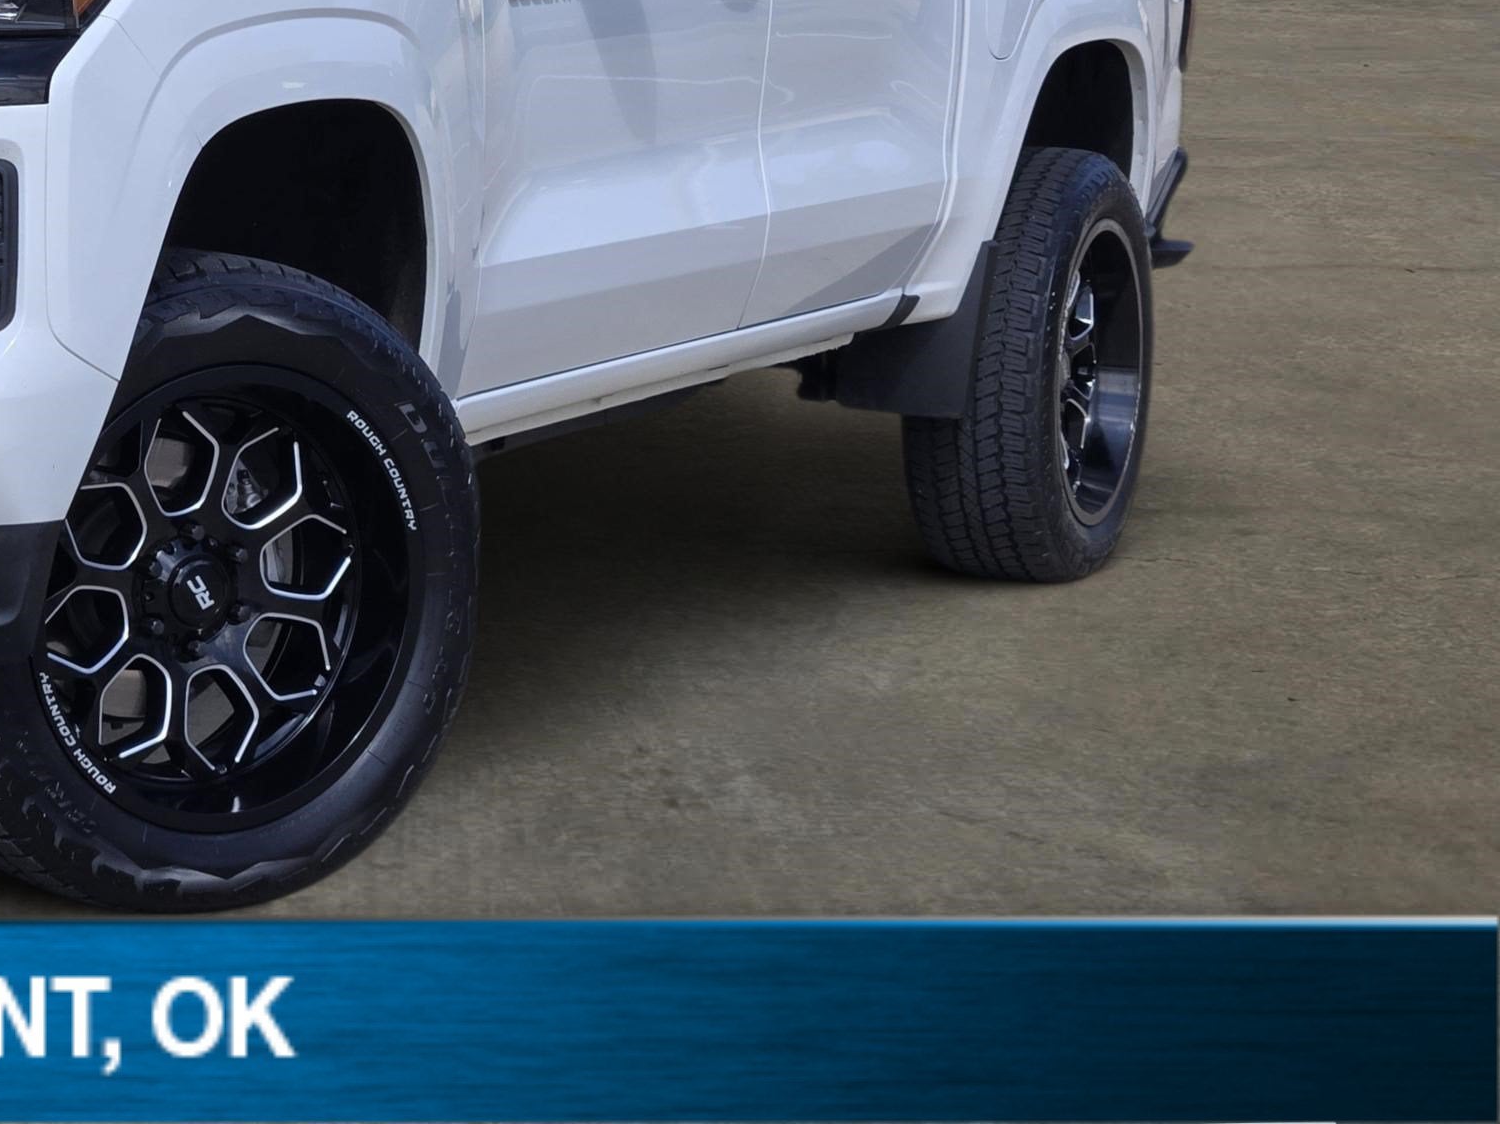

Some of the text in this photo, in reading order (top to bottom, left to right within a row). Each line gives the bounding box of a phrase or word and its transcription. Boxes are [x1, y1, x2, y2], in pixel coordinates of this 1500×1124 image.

[345, 409, 417, 531] ROUGH COUNTRY
[39, 672, 76, 747] COUNTRY
[72, 748, 117, 795] ROUGH
